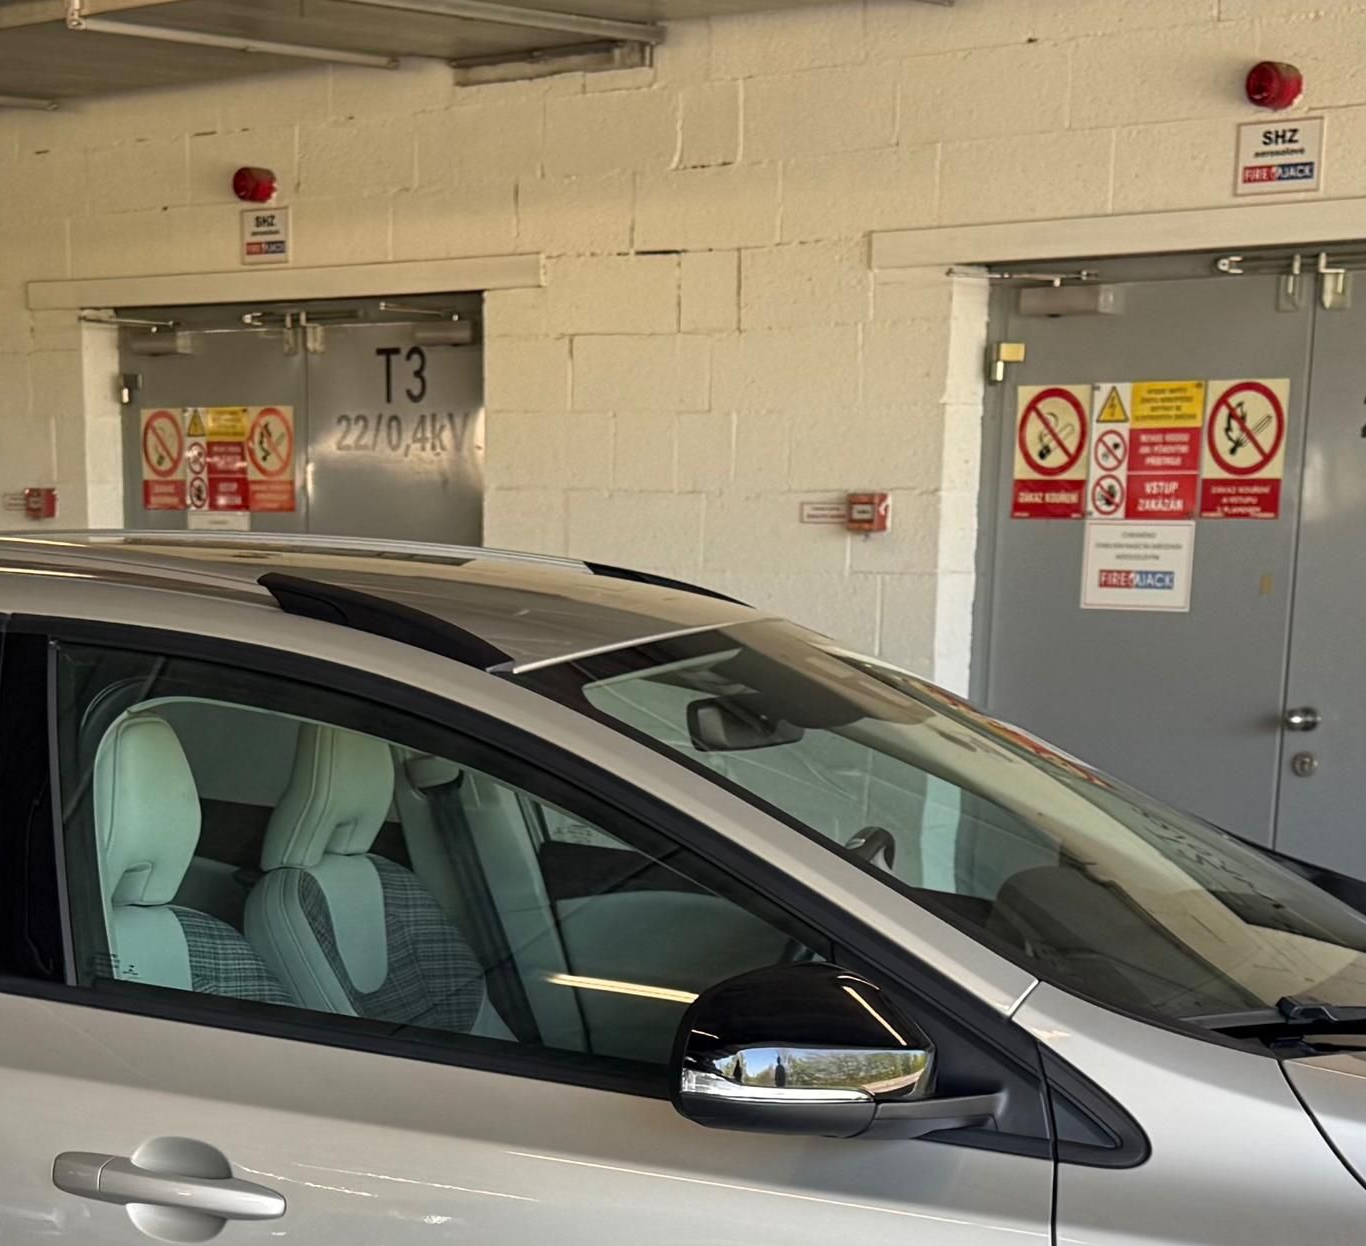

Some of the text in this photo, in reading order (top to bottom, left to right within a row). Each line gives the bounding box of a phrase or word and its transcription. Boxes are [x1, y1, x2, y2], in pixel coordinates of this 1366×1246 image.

[1262, 128, 1299, 146] SHZ
[375, 346, 427, 404] T3
[336, 413, 470, 458] 22/0,4kV
